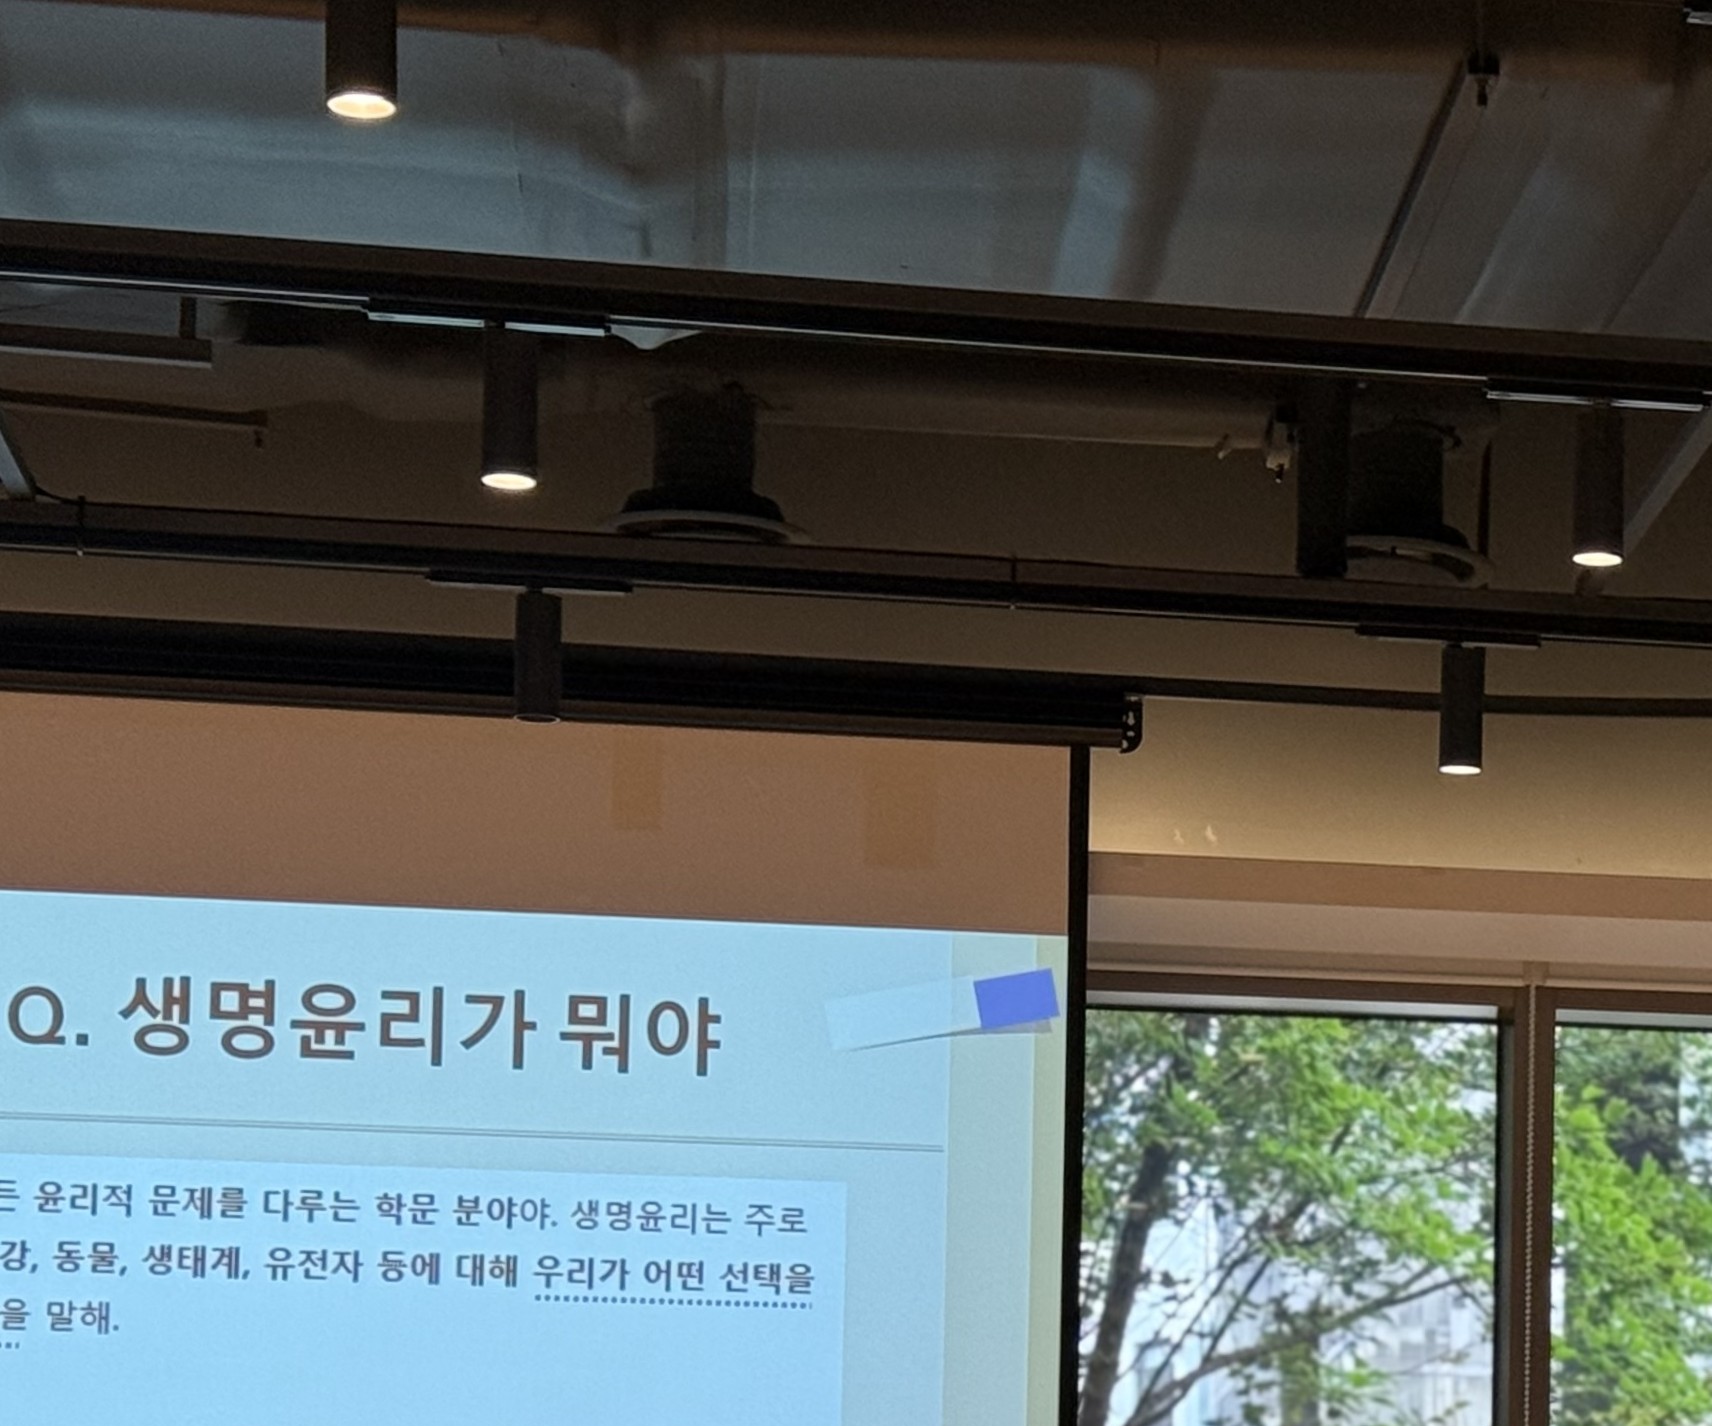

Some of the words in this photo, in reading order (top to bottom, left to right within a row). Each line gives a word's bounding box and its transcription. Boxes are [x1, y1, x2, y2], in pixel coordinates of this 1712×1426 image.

[7, 986, 90, 1048] Q.
[117, 976, 539, 1072] 생명윤리가
[558, 994, 723, 1079] 뭐야
[33, 1181, 134, 1220] 윤리적
[148, 1185, 250, 1222] 문제를
[263, 1189, 362, 1225] 다루는
[375, 1193, 441, 1228] 학문
[452, 1195, 559, 1232] 분야야.
[570, 1200, 733, 1237] 생명윤리는
[744, 1204, 809, 1239] 주로
[0, 1240, 40, 1275] 강,
[52, 1241, 129, 1278] 동물,
[141, 1245, 252, 1281] 생태계,
[264, 1248, 366, 1285] 유전자
[377, 1251, 442, 1287] 등에
[456, 1254, 519, 1289] 대해
[533, 1256, 632, 1293] 우리가
[643, 1260, 706, 1294] 어떤
[719, 1262, 816, 1297] 선택을
[0, 1299, 33, 1332] 을
[46, 1301, 121, 1336] 말해.
